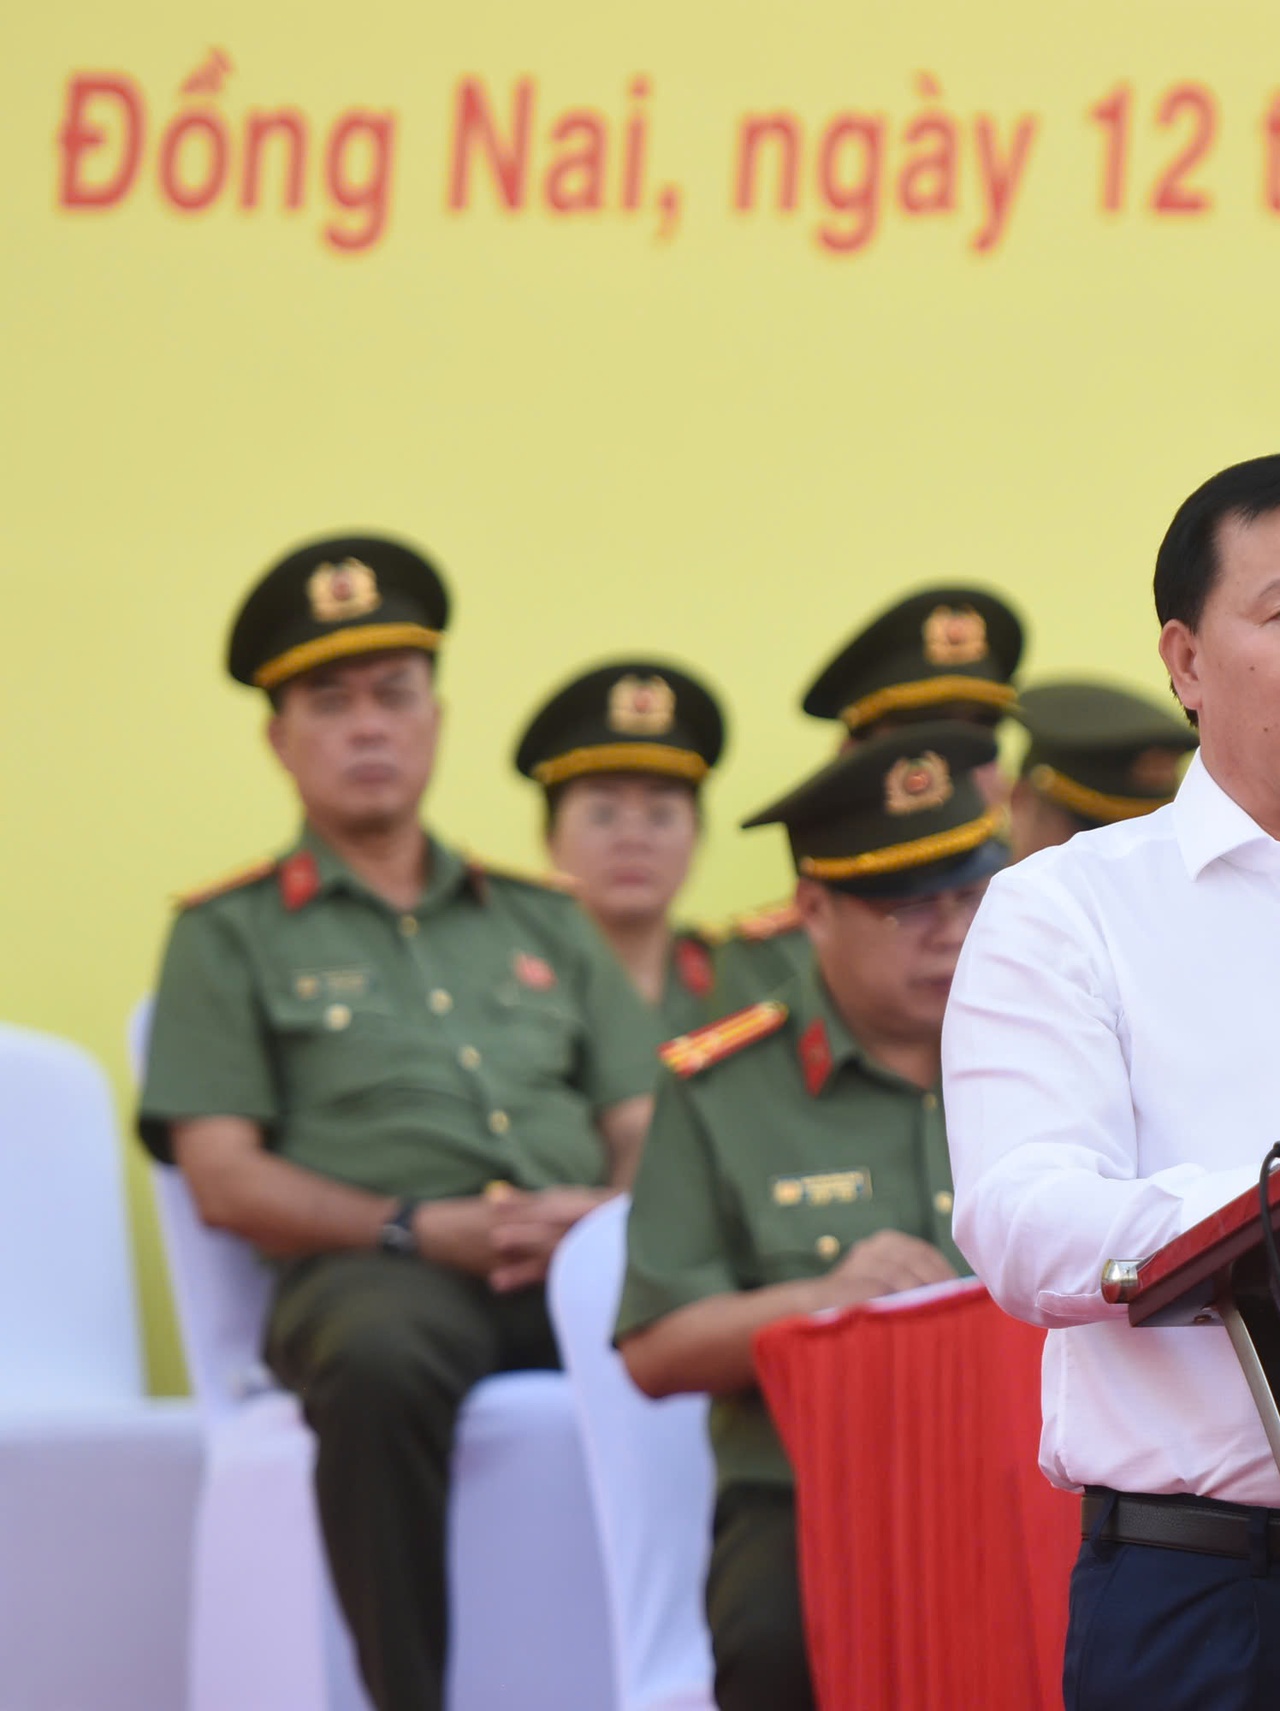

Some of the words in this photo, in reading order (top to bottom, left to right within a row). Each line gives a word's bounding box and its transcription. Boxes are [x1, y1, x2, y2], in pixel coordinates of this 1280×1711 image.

[55, 50, 397, 255] Đồng
[446, 75, 680, 245] Nai,
[733, 74, 1035, 255] ngày
[1091, 82, 1217, 216] 12
